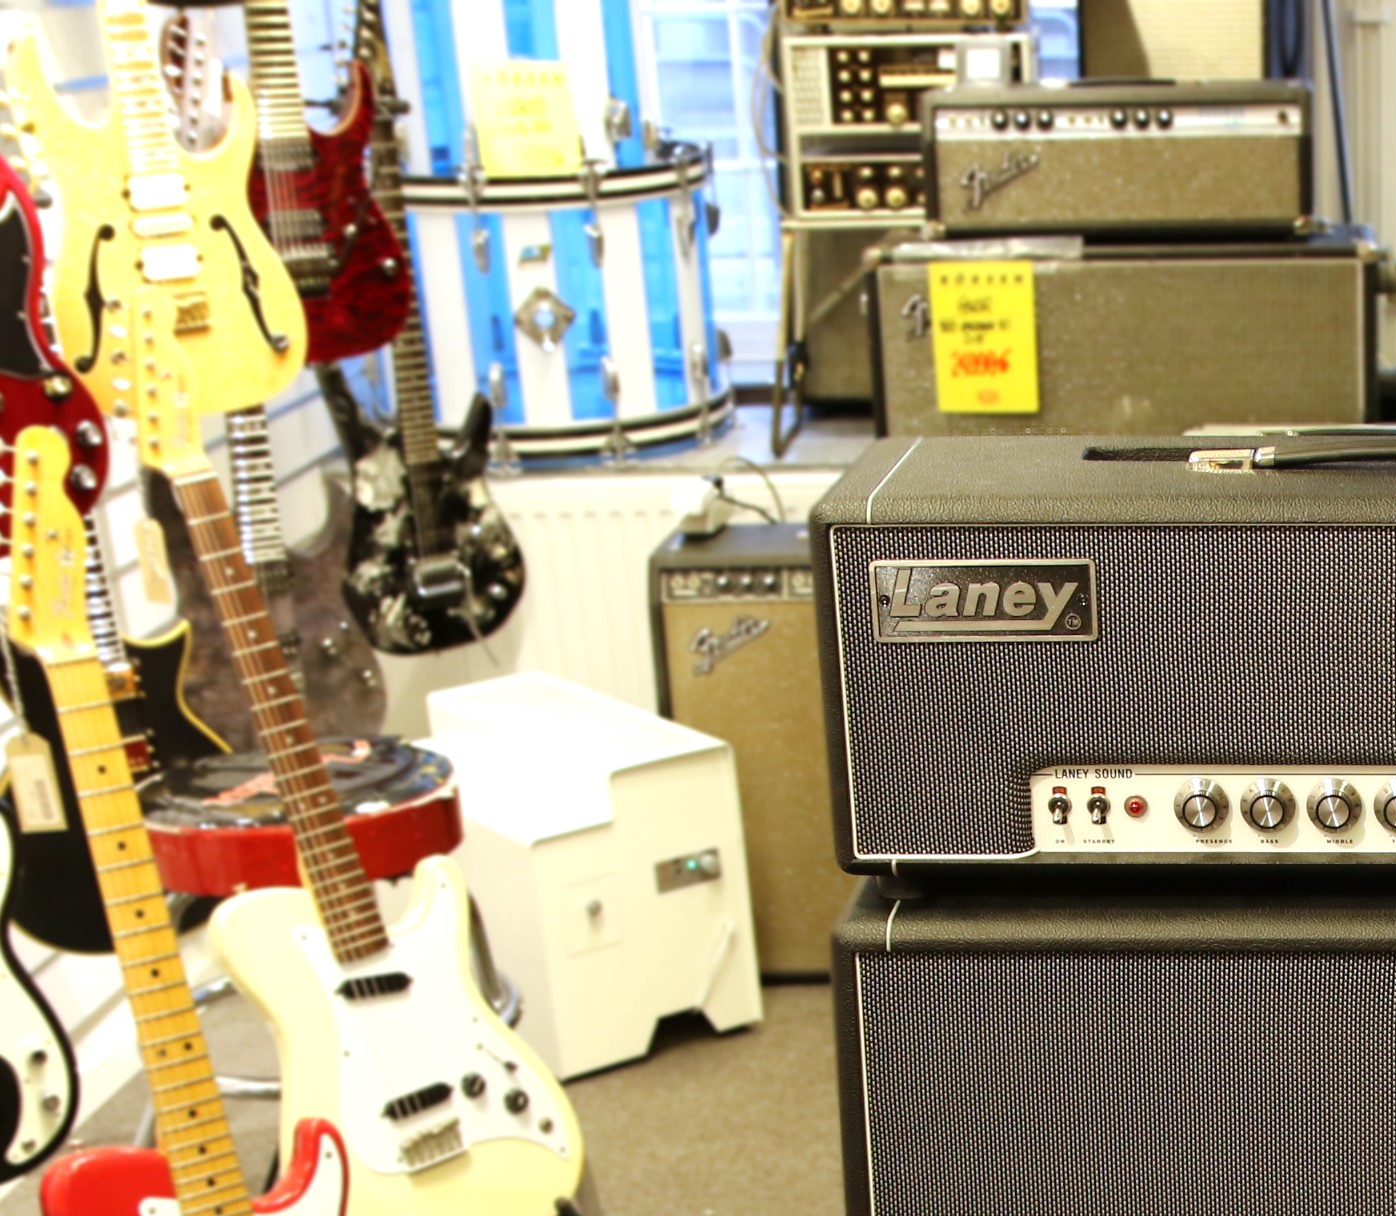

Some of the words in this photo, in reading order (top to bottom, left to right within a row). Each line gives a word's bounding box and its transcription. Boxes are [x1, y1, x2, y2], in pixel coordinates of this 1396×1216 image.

[890, 568, 1078, 631] Laney
[1054, 768, 1089, 779] LANEY
[1095, 768, 1133, 779] SOUND
